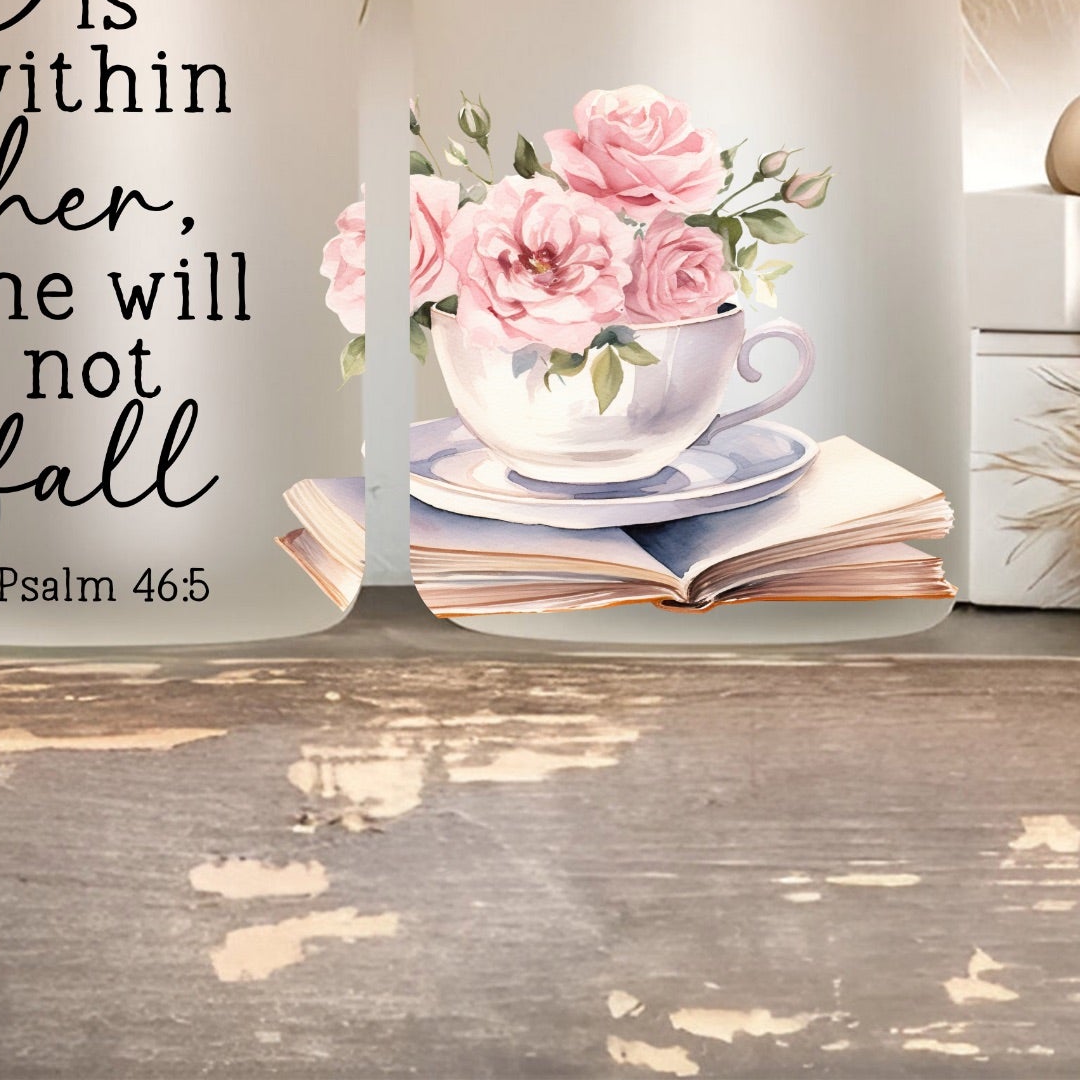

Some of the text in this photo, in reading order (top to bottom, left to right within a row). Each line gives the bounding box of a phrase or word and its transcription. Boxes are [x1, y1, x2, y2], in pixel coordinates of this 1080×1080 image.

[107, 251, 252, 322] will
[23, 338, 162, 400] not
[132, 567, 210, 603] 46:5
